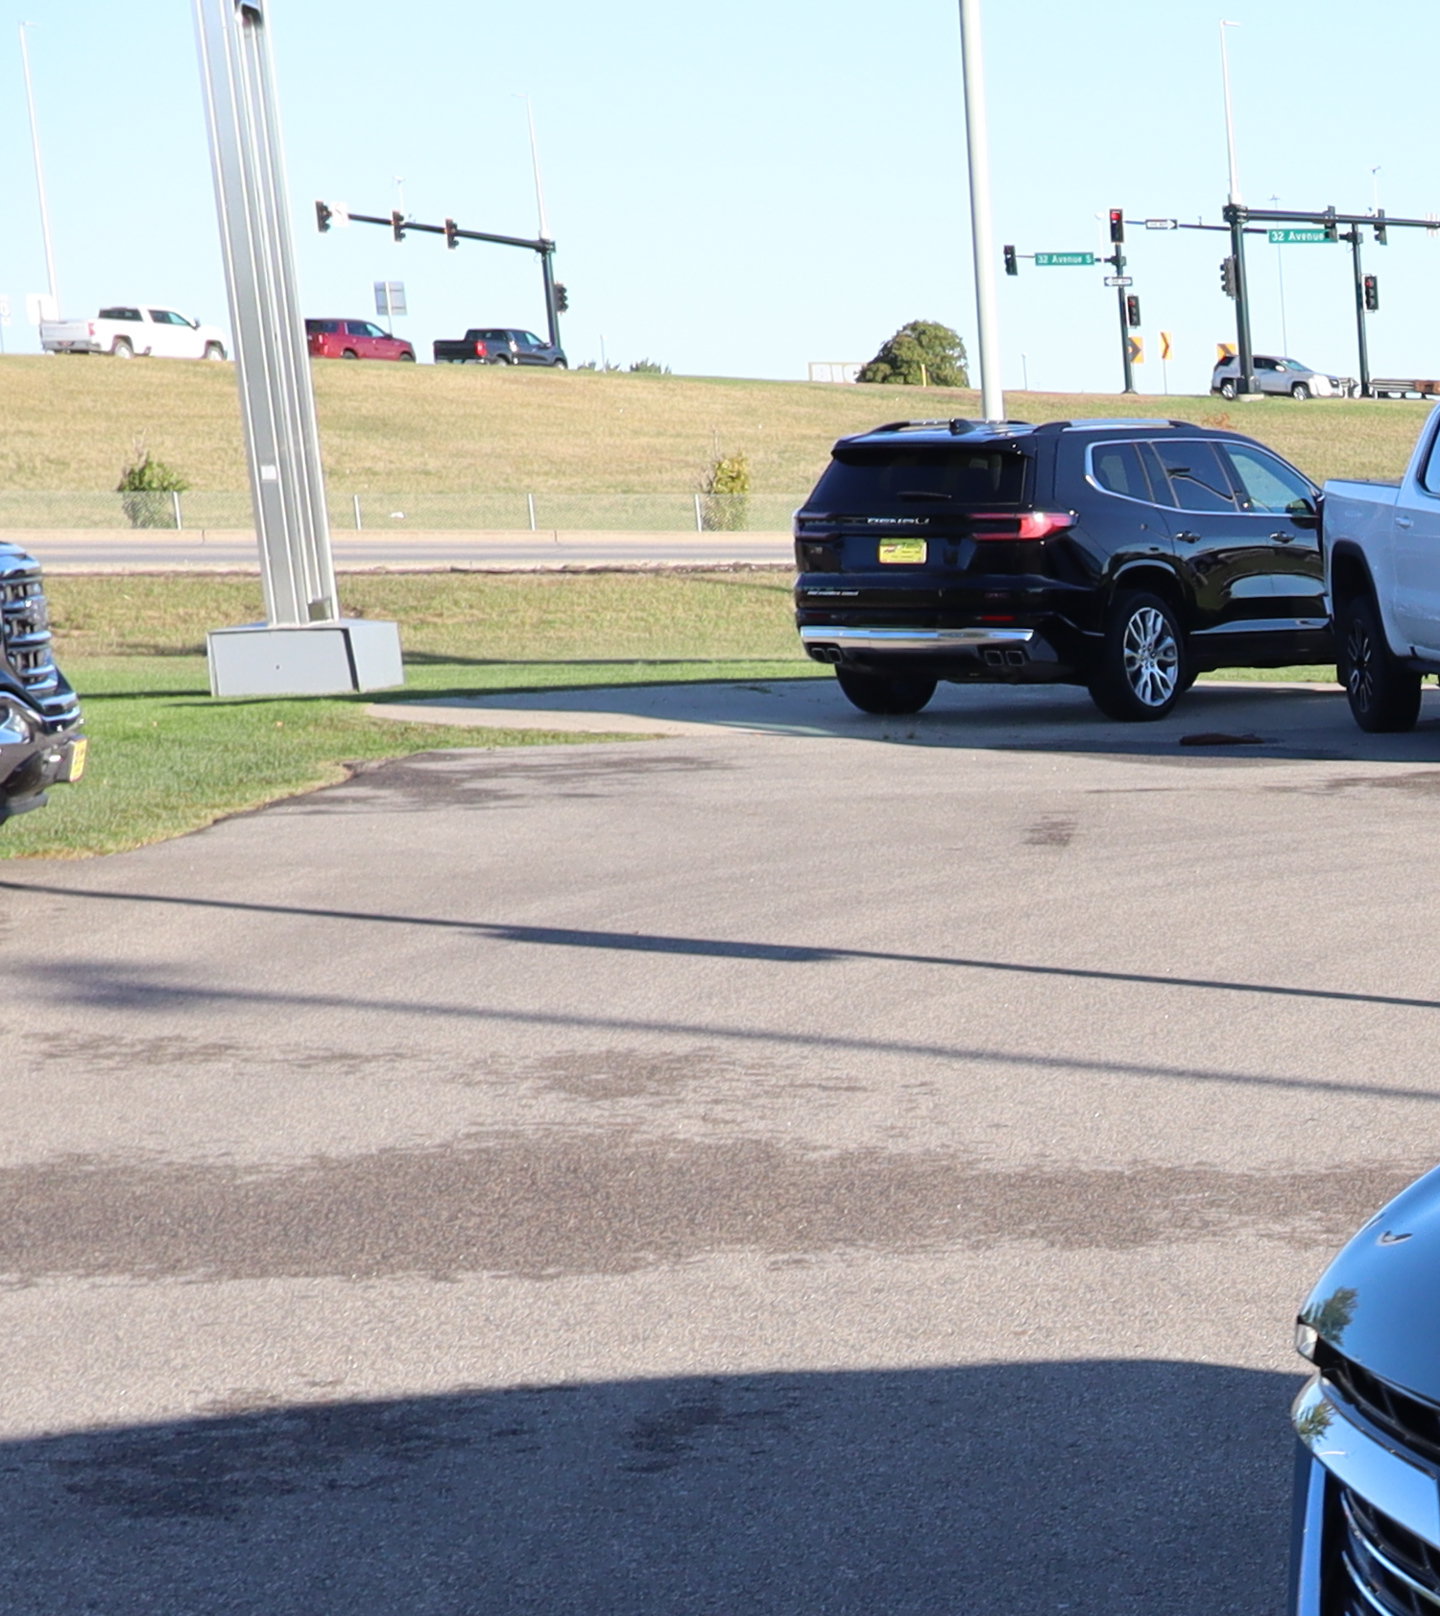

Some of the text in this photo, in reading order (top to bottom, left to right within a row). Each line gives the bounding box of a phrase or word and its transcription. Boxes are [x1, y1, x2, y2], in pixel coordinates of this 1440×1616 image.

[1271, 230, 1325, 241] 32 Avenue
[1051, 254, 1082, 263] Avenue
